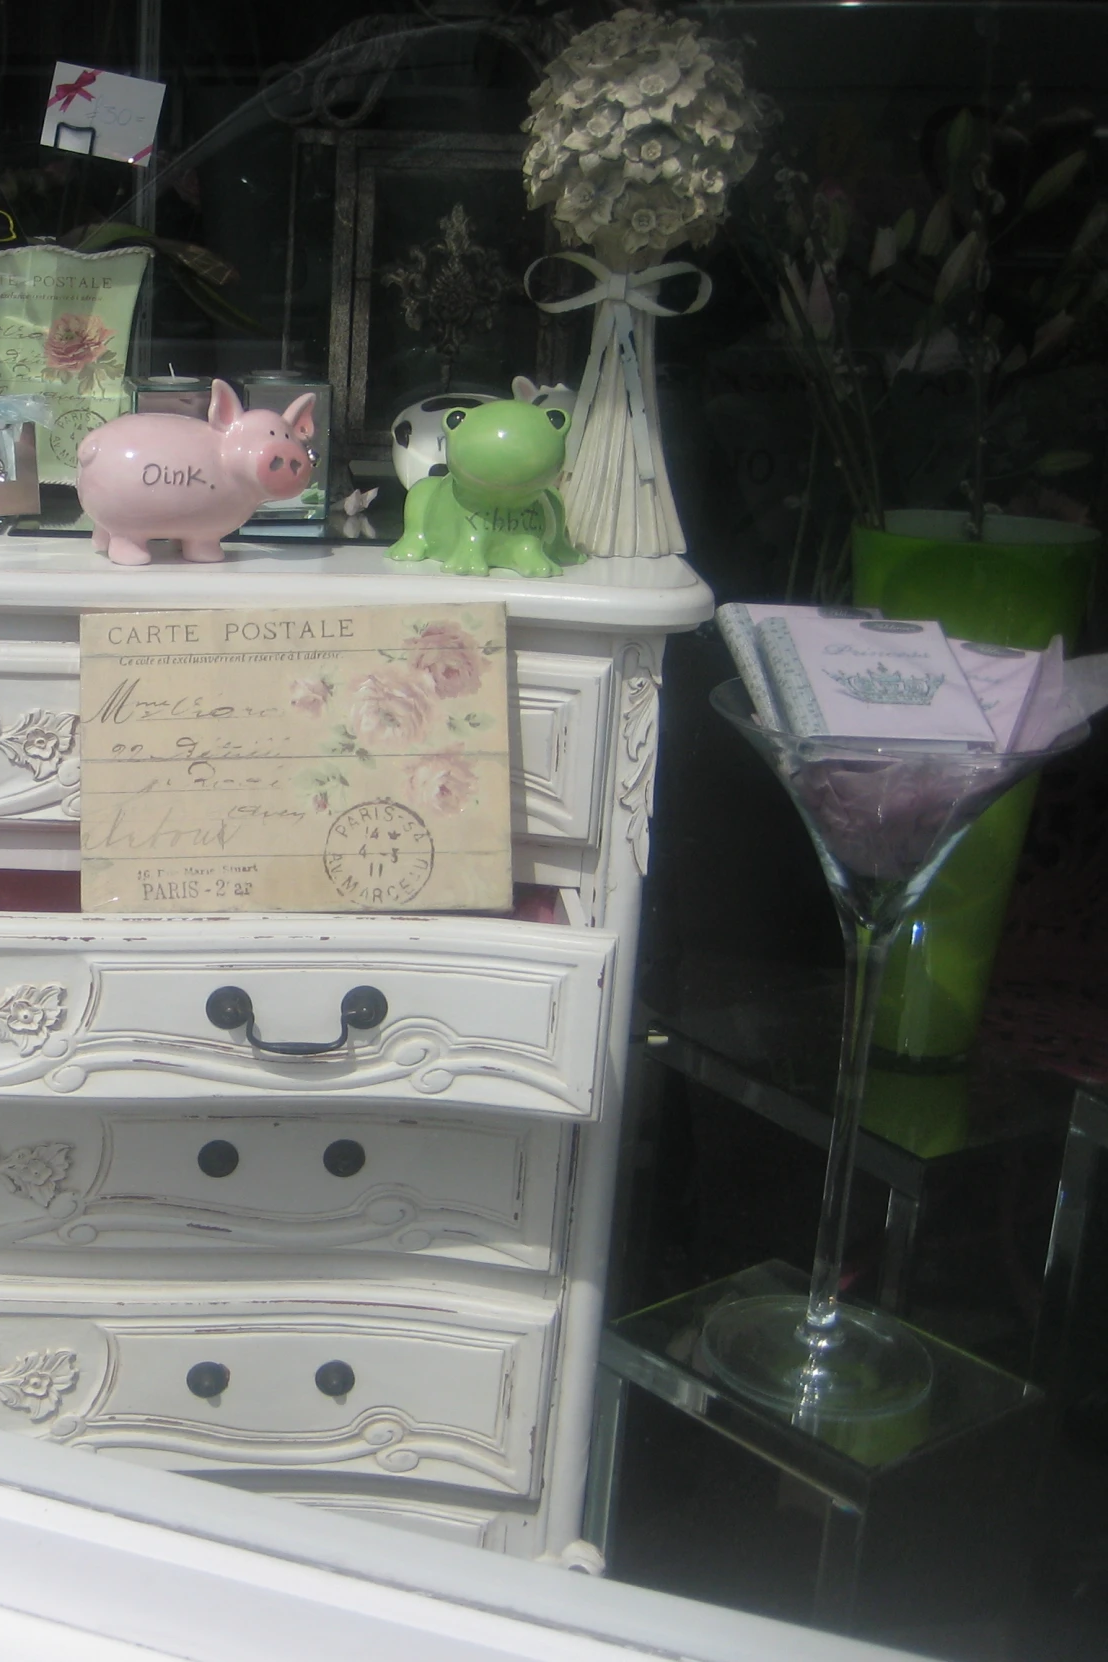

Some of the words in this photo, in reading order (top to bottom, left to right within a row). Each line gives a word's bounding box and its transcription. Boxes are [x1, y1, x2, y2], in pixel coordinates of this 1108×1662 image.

[32, 275, 113, 290] POSTALE
[142, 463, 215, 490] Oink.
[107, 624, 200, 646] CARTE
[224, 618, 355, 642] POSTALE
[142, 880, 200, 901] PARIS
